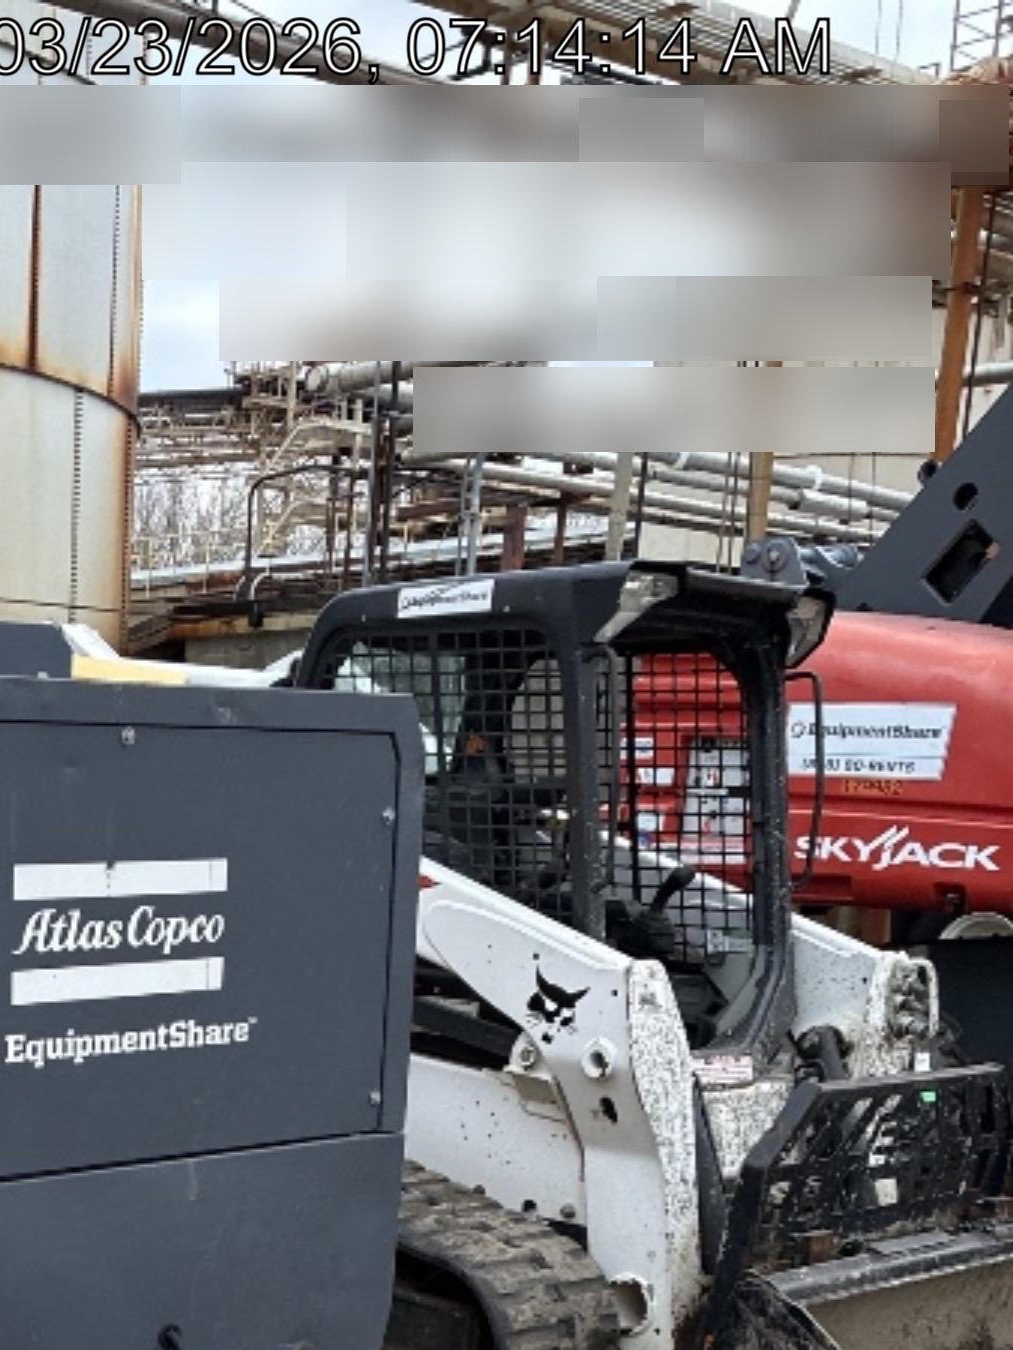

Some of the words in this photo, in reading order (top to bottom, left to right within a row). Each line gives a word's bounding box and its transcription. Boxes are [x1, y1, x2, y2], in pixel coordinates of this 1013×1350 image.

[808, 722, 943, 739] EuipmentShare
[794, 825, 1001, 871] SKYJACK
[5, 1019, 251, 1068] EquipmentShare
